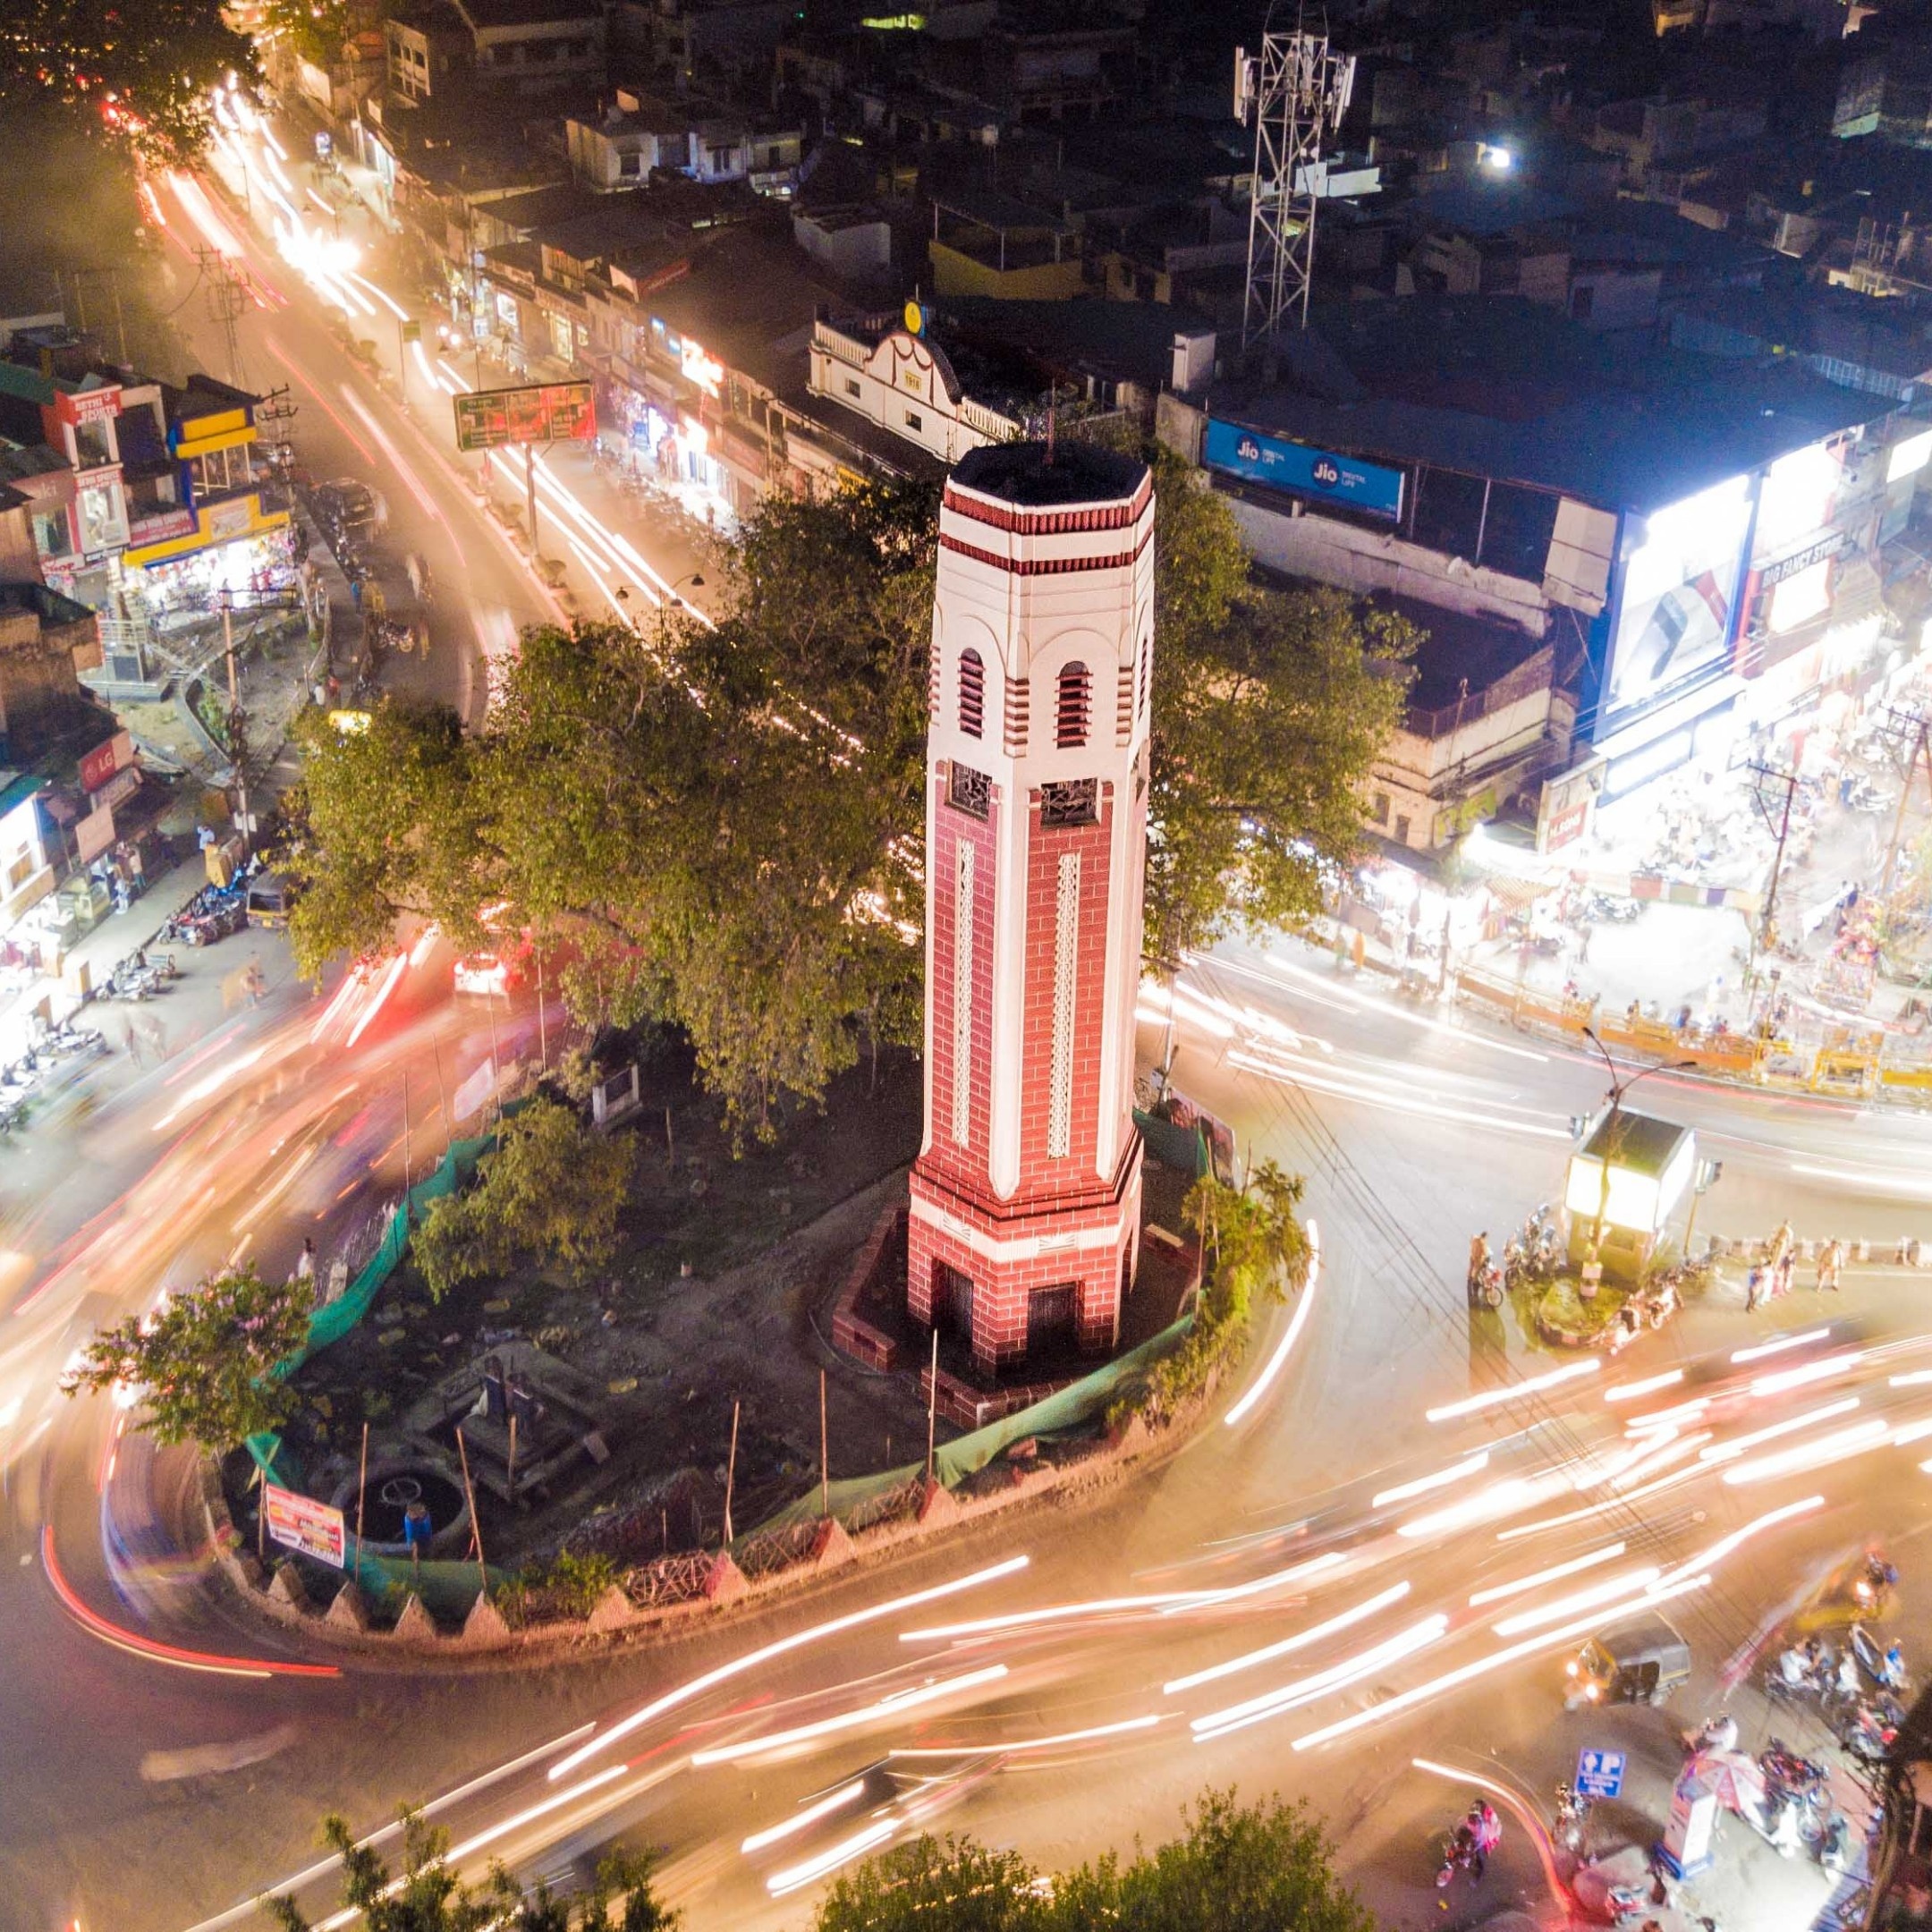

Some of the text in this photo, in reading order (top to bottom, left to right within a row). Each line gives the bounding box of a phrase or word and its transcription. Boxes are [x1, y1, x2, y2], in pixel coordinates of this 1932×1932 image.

[1238, 441, 1258, 461] Jio
[1314, 462, 1338, 482] Jio
[1781, 548, 1814, 580] FANCY
[98, 751, 114, 771] LG
